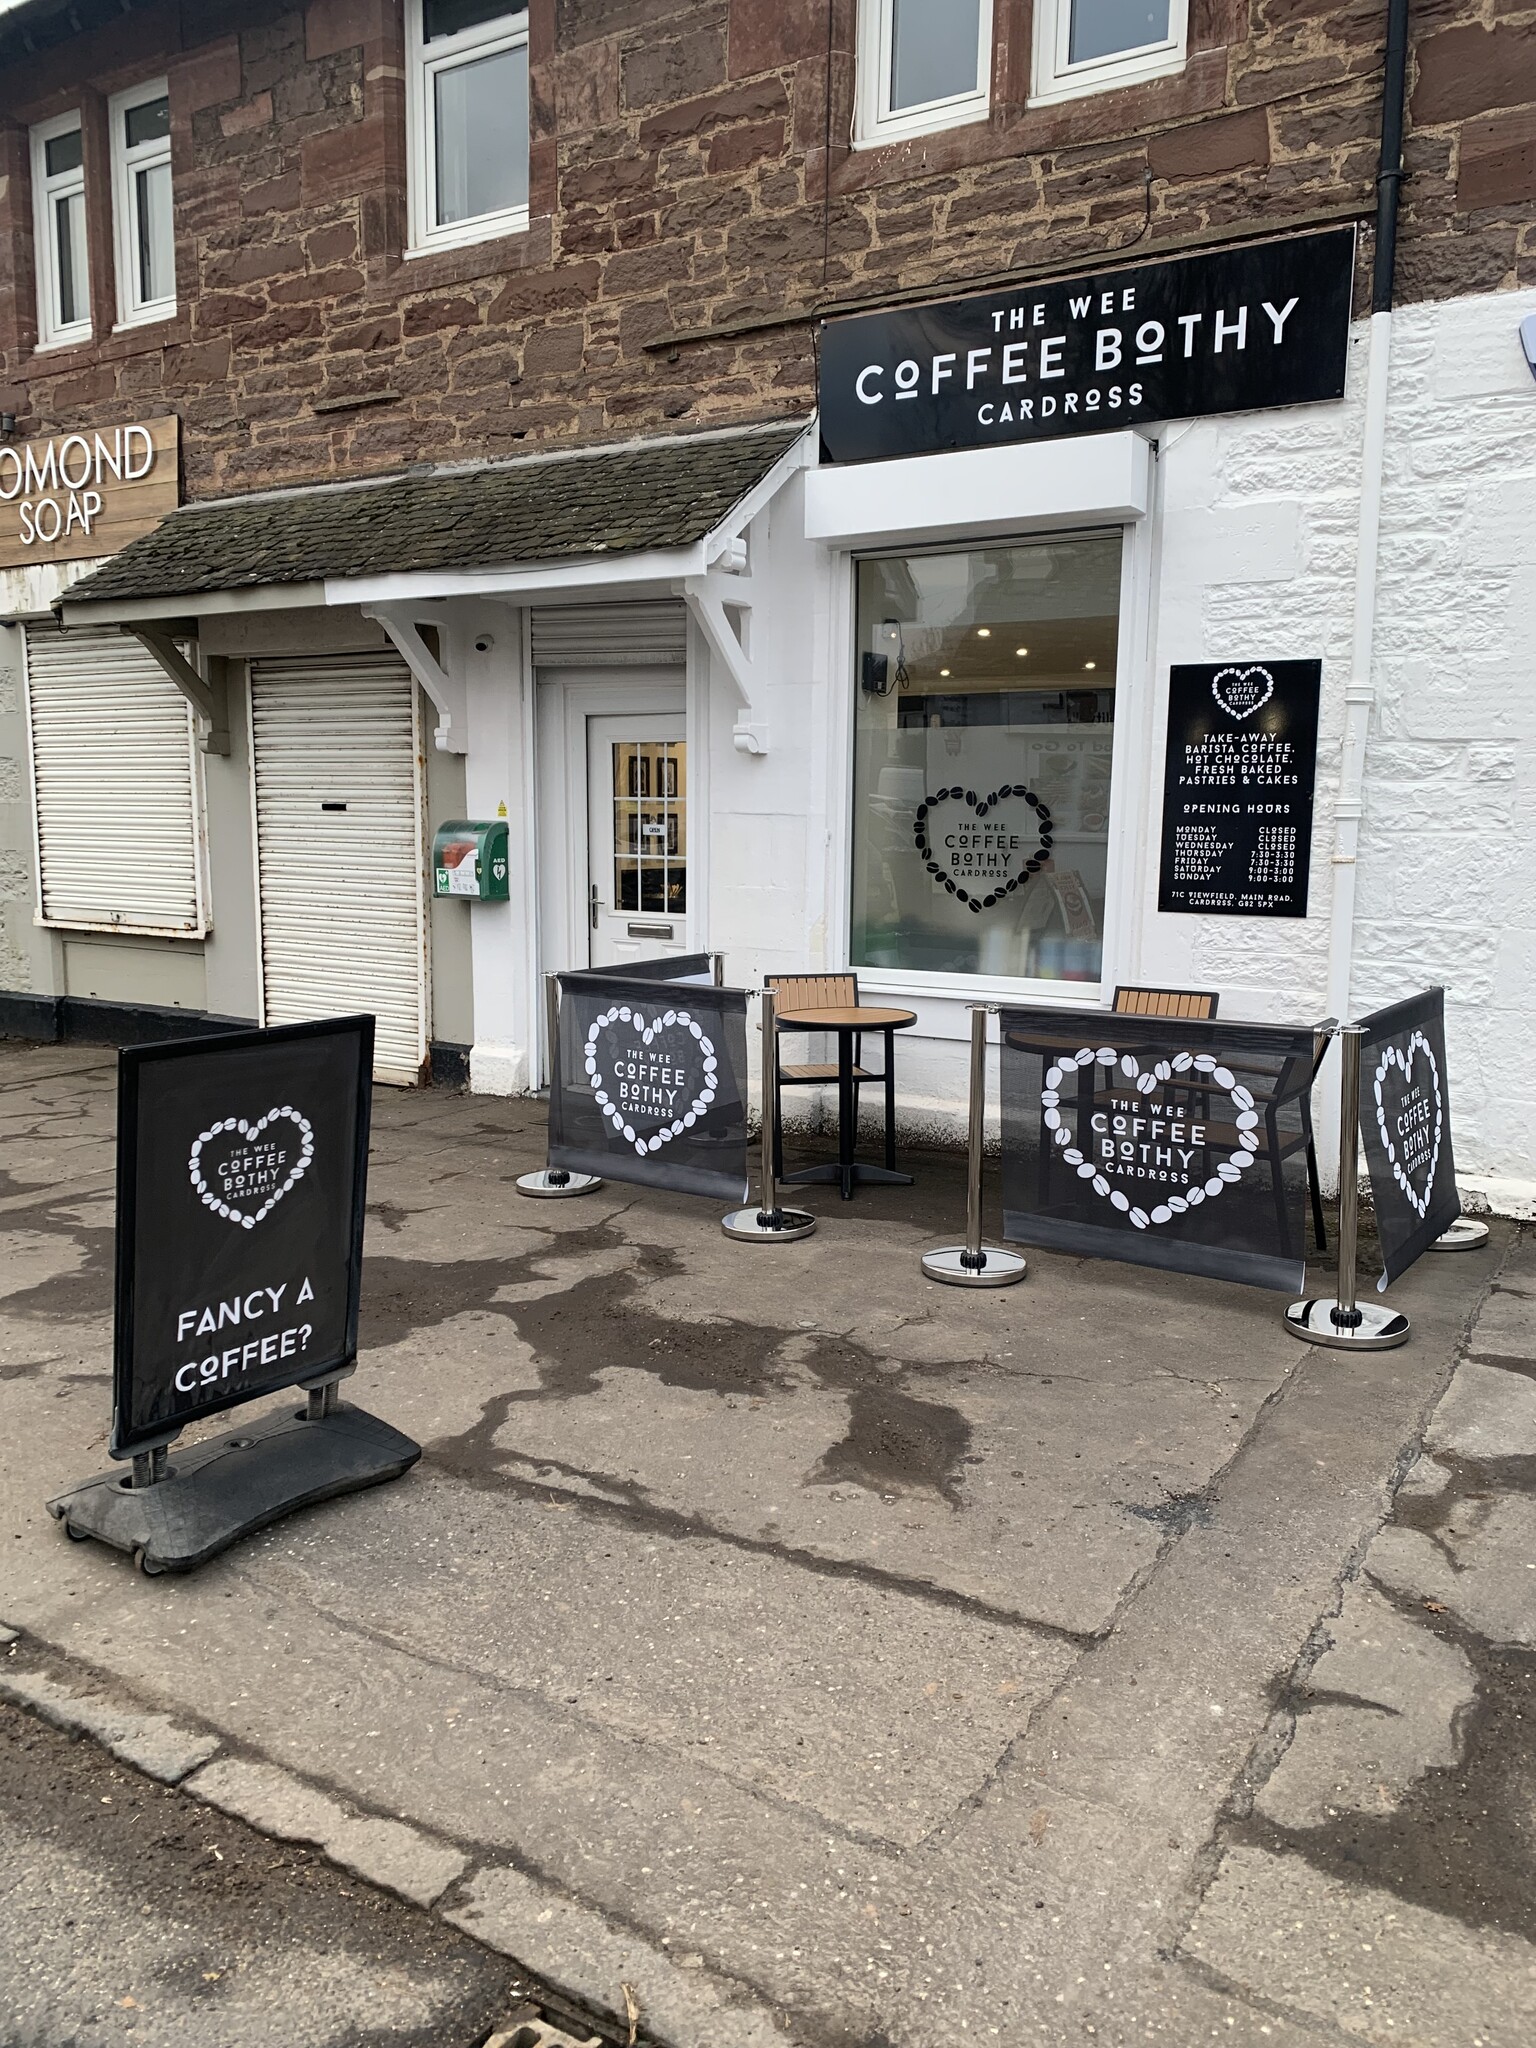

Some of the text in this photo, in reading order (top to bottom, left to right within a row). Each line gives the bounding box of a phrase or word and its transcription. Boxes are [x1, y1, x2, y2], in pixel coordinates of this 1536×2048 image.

[992, 288, 1135, 332] THE WEE
[855, 297, 1299, 405] COFFEE BOTHY
[978, 383, 1142, 425] CARDROSS
[19, 490, 102, 544] SOAP
[1226, 686, 1259, 694] COFFEE
[1204, 733, 1277, 743] TAKE-AWAY
[1185, 744, 1234, 754] BARISTA
[1186, 755, 1208, 764] HOT
[1195, 765, 1281, 774] FRESH BAKED
[1179, 775, 1297, 785] PASTRIES & CAKES
[1184, 804, 1290, 813] OPENING HOURS
[945, 835, 1019, 849] COFFEE
[951, 853, 1011, 867] BOTHY
[1175, 849, 1223, 857] THURSDAY
[1175, 865, 1293, 875] SATURDAY 9:00-3:00
[1251, 859, 1294, 867] 7:30-3:30
[953, 869, 1008, 878] CARDROSS
[1248, 875, 1293, 883] 9:00-3:00
[627, 1049, 643, 1060] THE
[649, 1053, 670, 1063] WEE
[614, 1062, 686, 1086] COFFEE
[620, 1083, 678, 1106] BOTHY
[1401, 1086, 1421, 1107] THE WEE
[622, 1101, 673, 1118] CARDROSS
[1111, 1099, 1184, 1117] THE WEE
[1397, 1099, 1431, 1137] COFFEE
[1090, 1112, 1206, 1146] COFFEE
[231, 1143, 275, 1157] THE WEE
[1403, 1124, 1430, 1161] BOTHY
[1101, 1138, 1195, 1169] BOTHY
[1408, 1149, 1431, 1174] CARDROSS
[218, 1151, 287, 1176] COFFEE
[1105, 1160, 1188, 1184] CARDROSS
[224, 1168, 280, 1192] BOTHY
[226, 1183, 276, 1200] CARDROSS
[177, 1277, 314, 1341] FANCY A
[175, 1323, 312, 1392] COFFEE?
